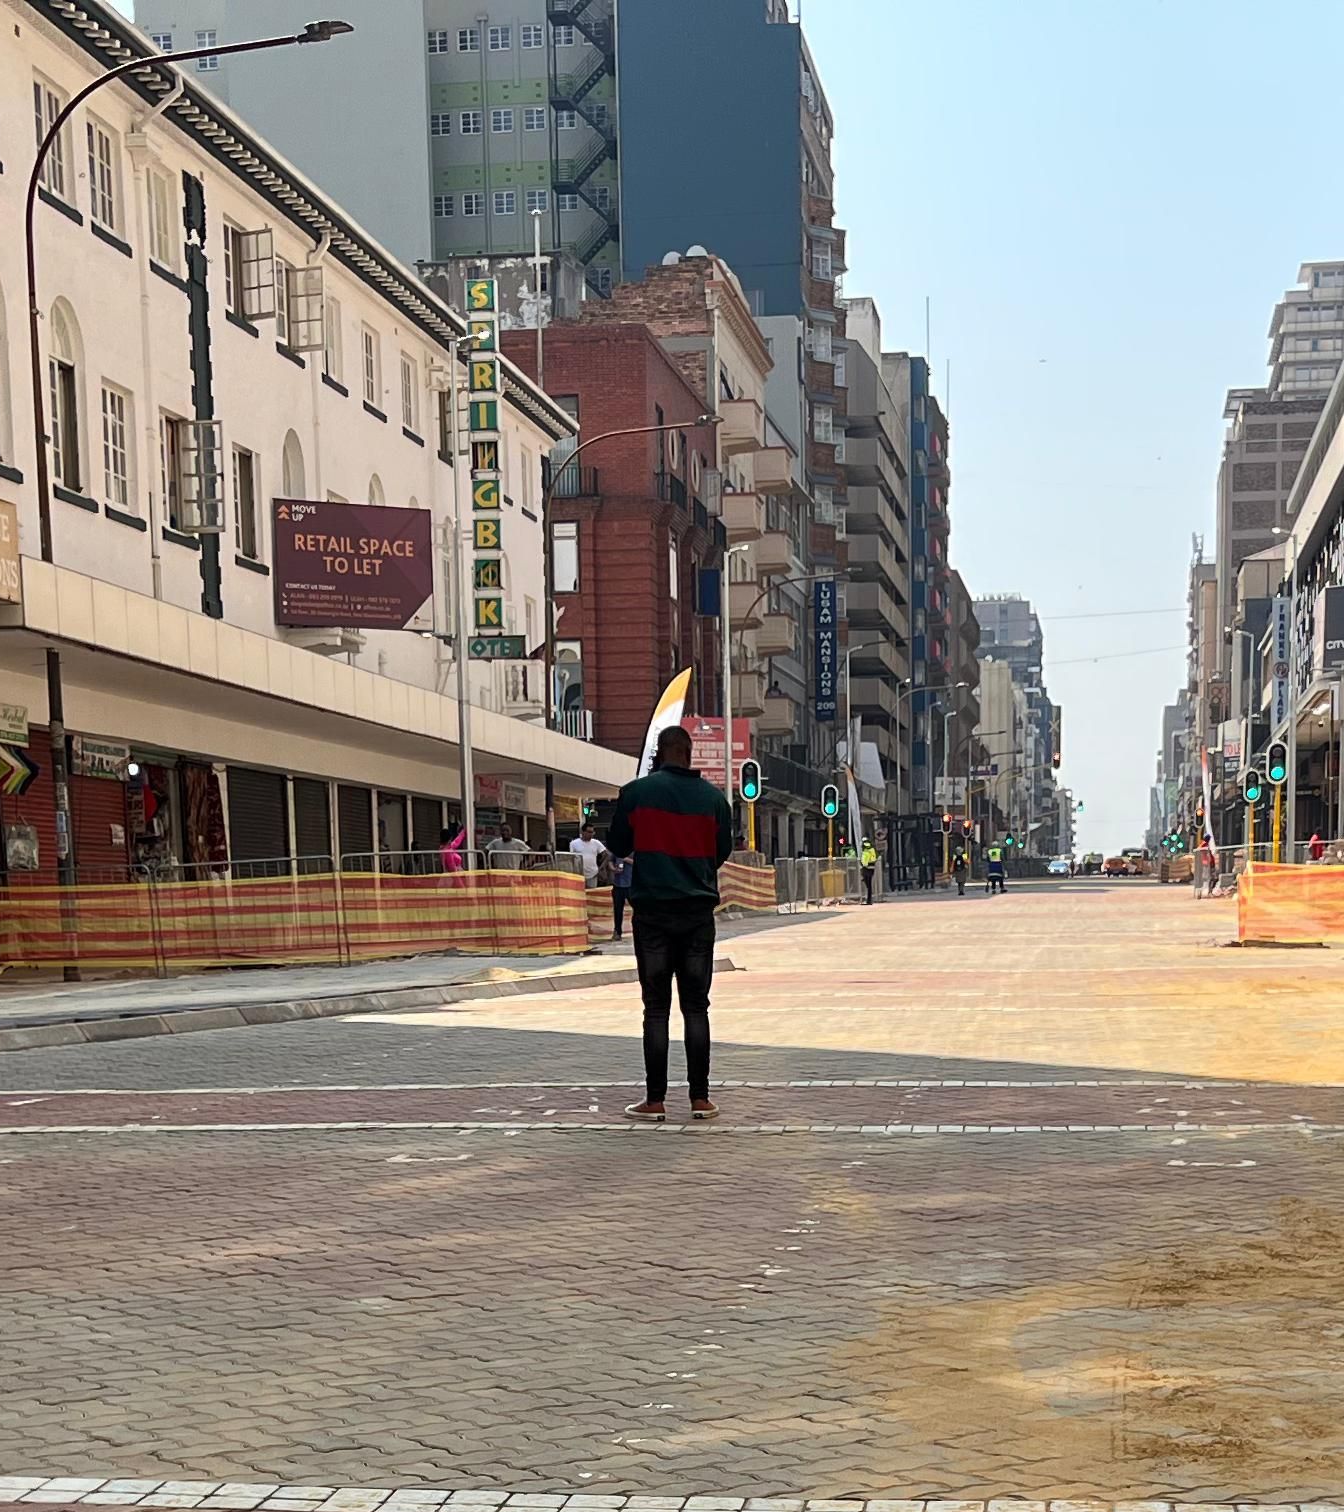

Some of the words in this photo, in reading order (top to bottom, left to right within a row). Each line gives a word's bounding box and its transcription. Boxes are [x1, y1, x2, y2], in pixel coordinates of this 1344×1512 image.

[292, 504, 316, 514] MOVE
[292, 514, 304, 522] UP
[294, 534, 355, 554] RETAIL
[359, 538, 415, 557] SPACE
[323, 556, 349, 574] TO
[354, 558, 384, 576] LET
[285, 582, 310, 590] CONTACT
[819, 583, 832, 624] LUSAM
[819, 631, 832, 696] MANSIONS
